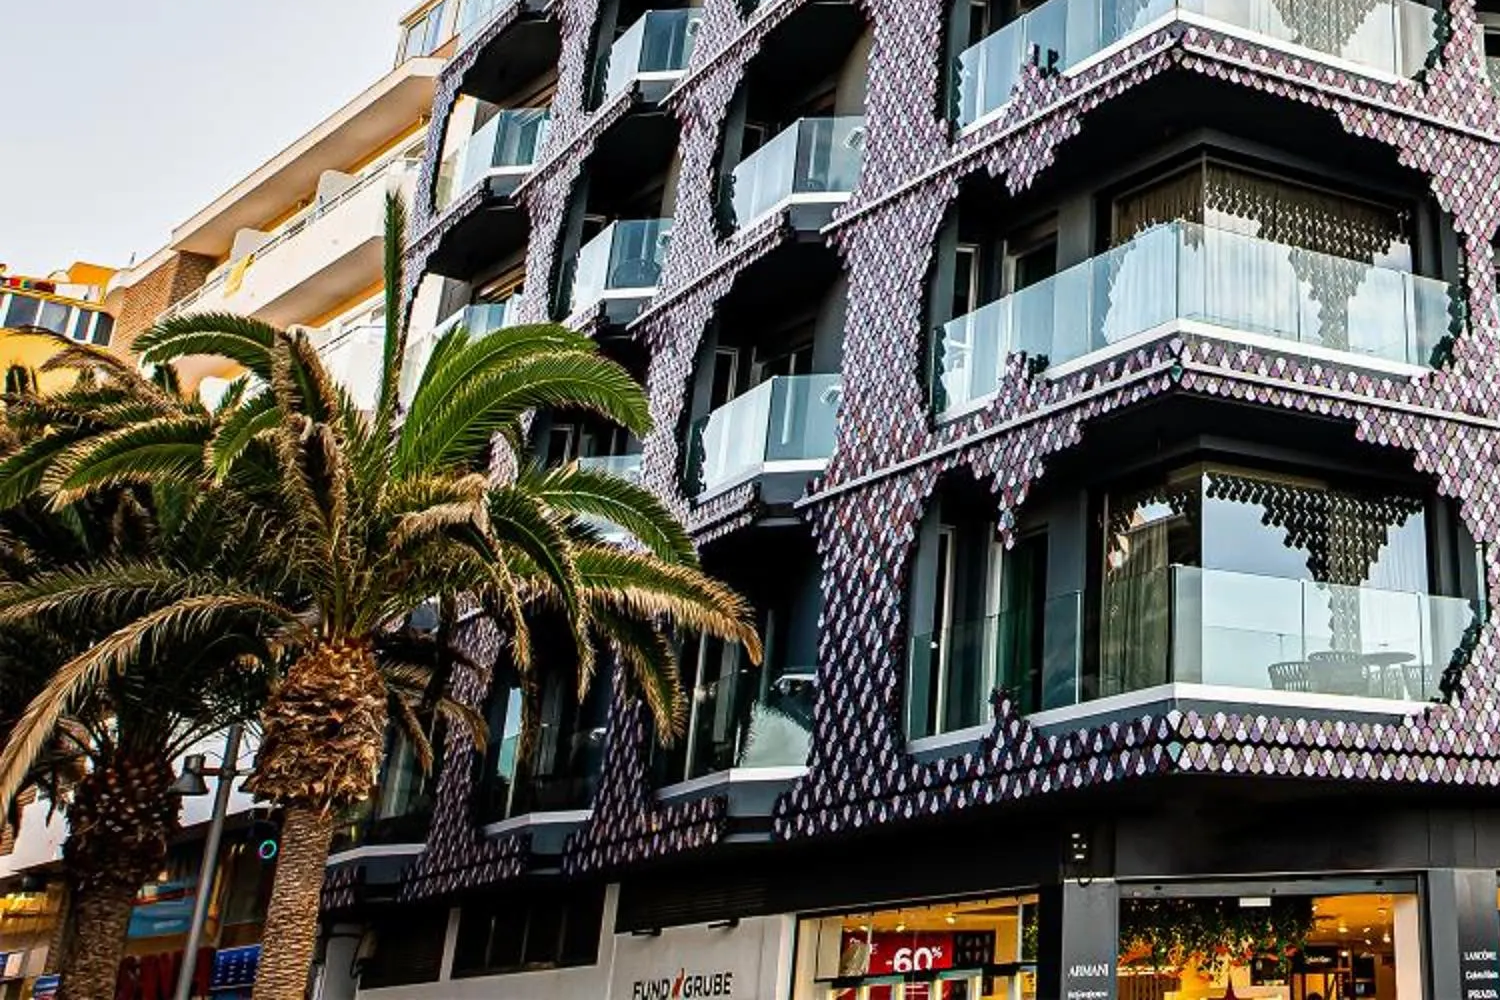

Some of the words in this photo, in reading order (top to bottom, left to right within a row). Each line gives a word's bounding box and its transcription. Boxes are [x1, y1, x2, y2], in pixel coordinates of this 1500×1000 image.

[885, 946, 943, 973] -60%
[1068, 963, 1109, 977] ARMANI
[683, 972, 733, 998] GRUBE
[1467, 989, 1499, 999] PRADA
